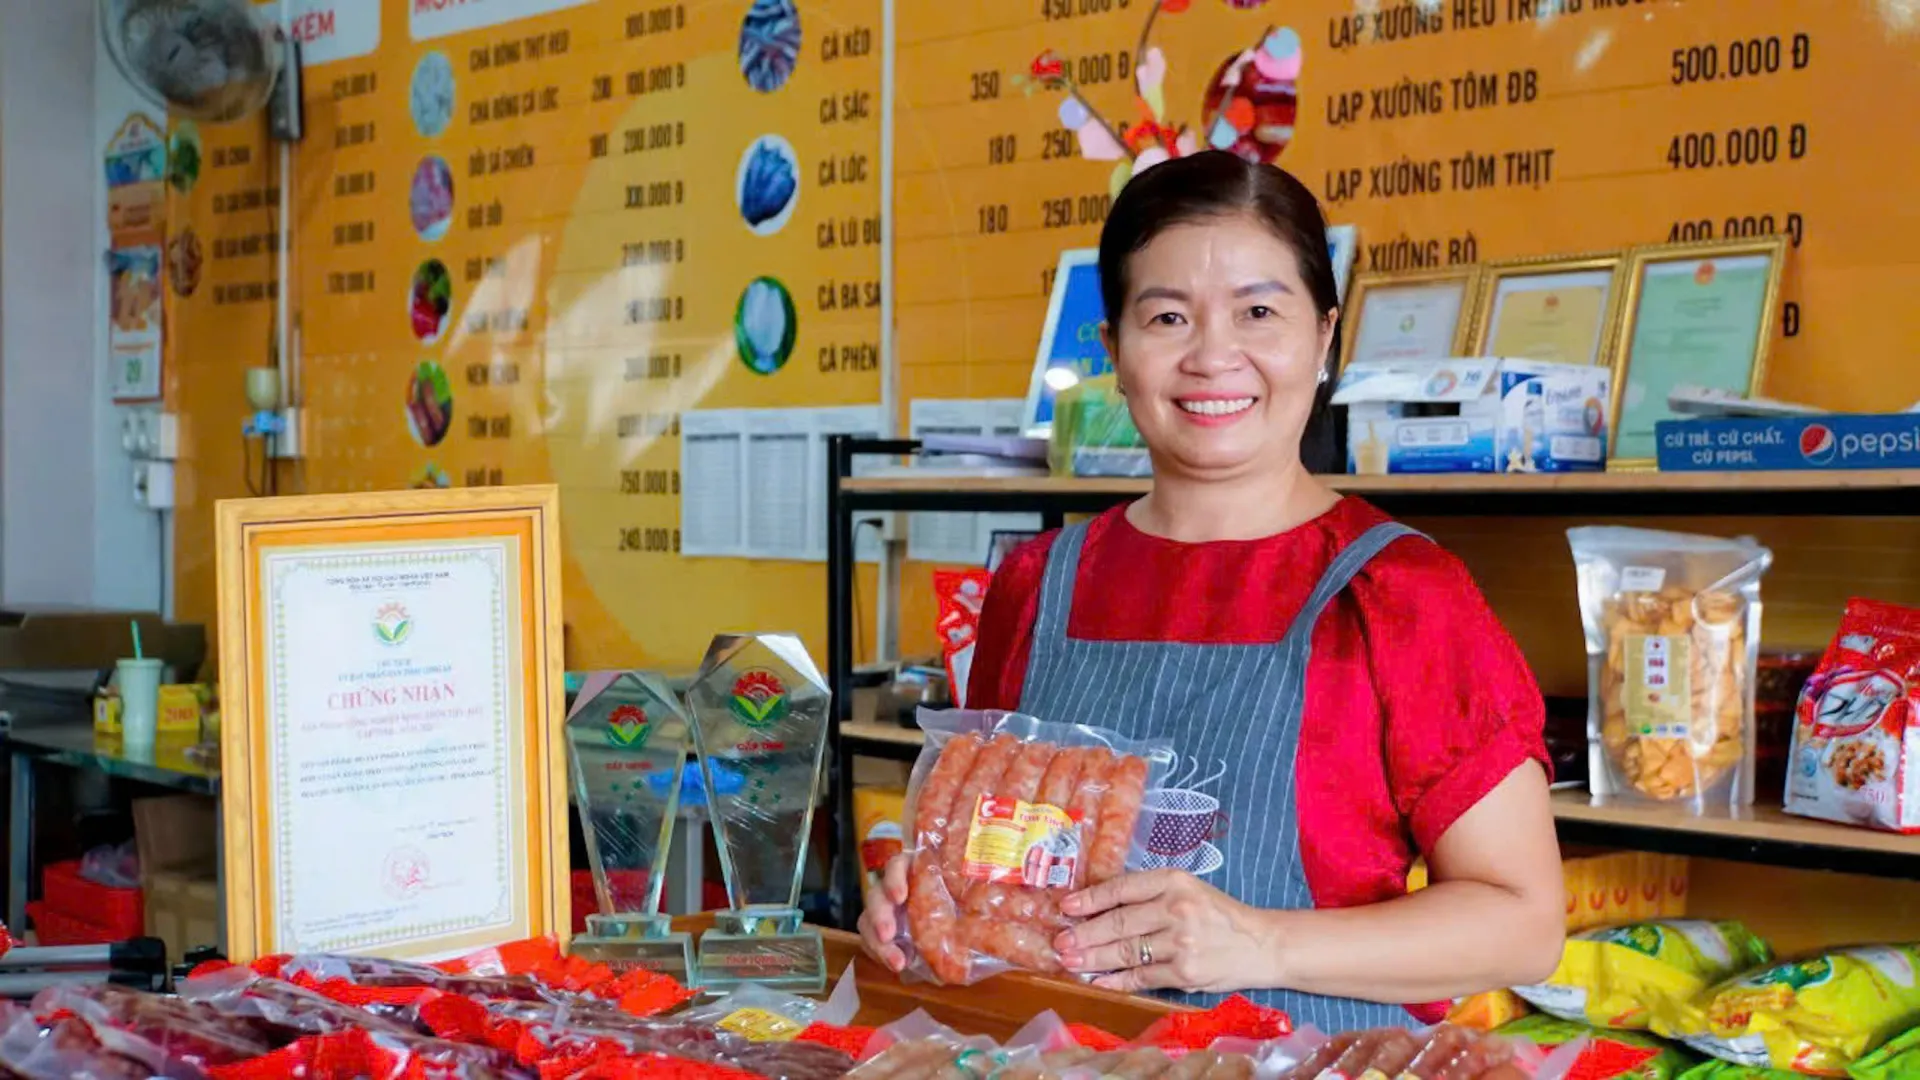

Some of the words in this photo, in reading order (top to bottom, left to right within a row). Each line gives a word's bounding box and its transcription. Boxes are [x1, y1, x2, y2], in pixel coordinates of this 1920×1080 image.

[821, 31, 839, 63] CÁ
[1671, 35, 1780, 85] 500.000
[1791, 33, 1810, 70] Đ
[970, 70, 999, 101] 350
[1119, 51, 1130, 80] Đ
[820, 92, 837, 124] CÁ
[1327, 91, 1363, 129] LẠP
[1450, 69, 1498, 111] TÔM
[1507, 68, 1538, 105] ĐB
[989, 133, 1017, 166] 180
[1042, 128, 1083, 162] 250.
[1667, 126, 1778, 171] 400.000
[1788, 123, 1807, 160] Đ
[819, 154, 836, 188] CÁ
[1326, 168, 1363, 208] LẠP
[1450, 151, 1496, 190] TÔM
[1504, 148, 1555, 191] THỊT
[978, 203, 1009, 235] 180
[1042, 195, 1110, 229] 250.000
[1668, 214, 1775, 244] 400000
[817, 216, 835, 250] CÁ
[1448, 231, 1478, 265] BÒ
[817, 279, 836, 312] CÁ
[841, 283, 859, 310] BA
[1783, 301, 1801, 338] Đ
[818, 342, 837, 373] CÁ
[1840, 426, 1920, 459] pepsi
